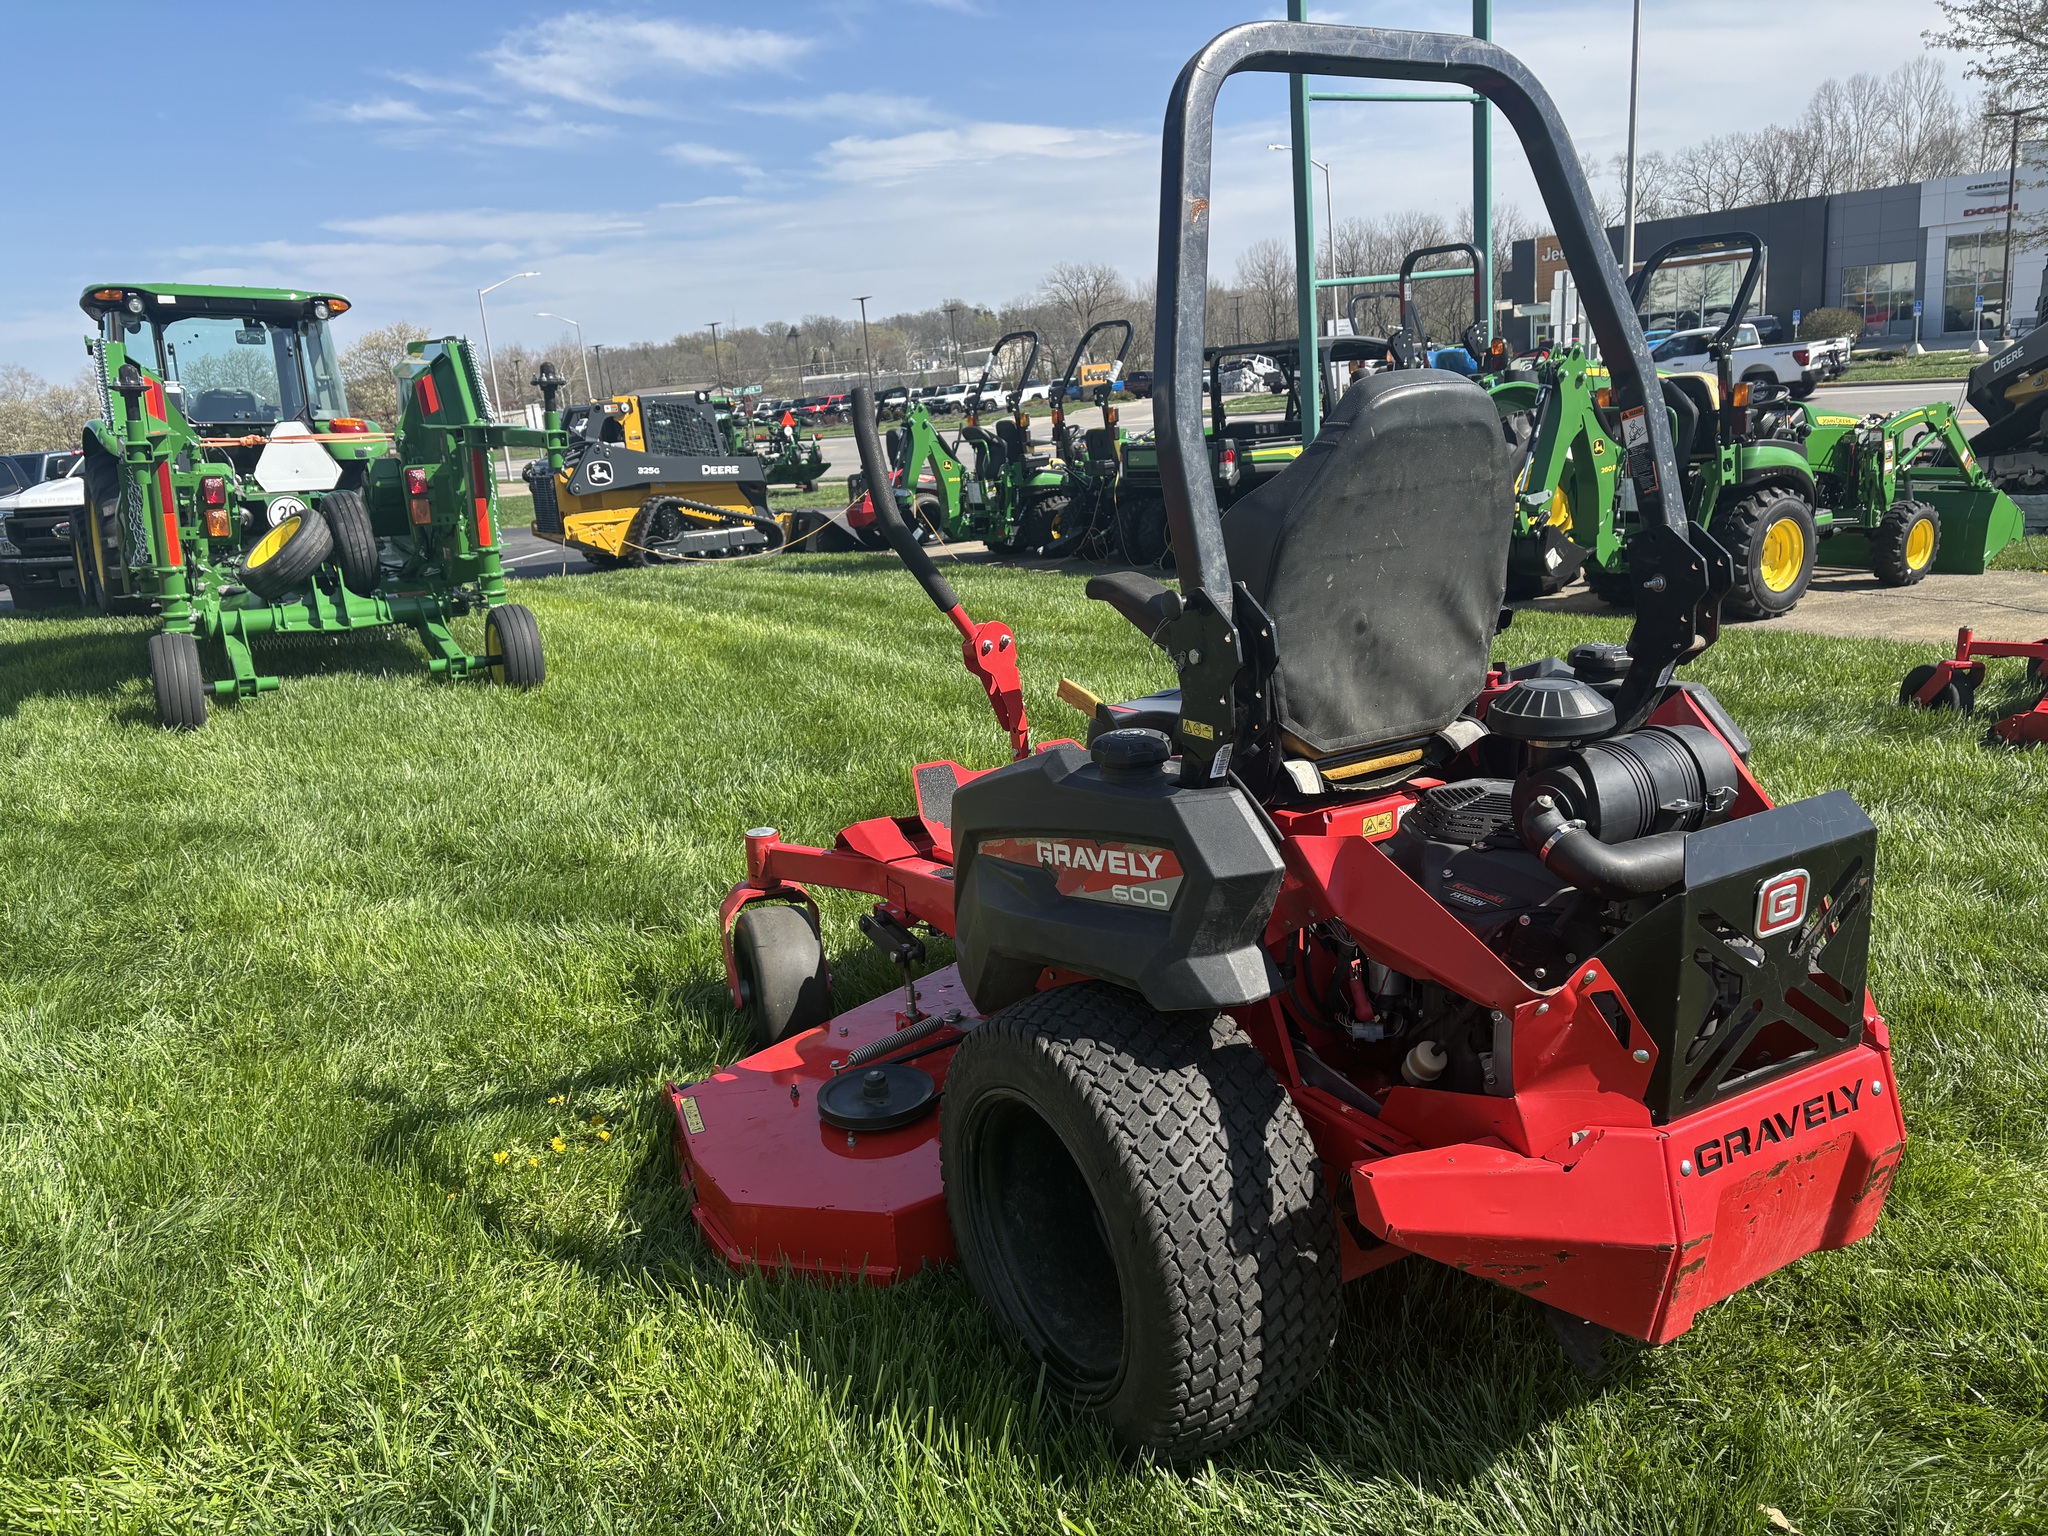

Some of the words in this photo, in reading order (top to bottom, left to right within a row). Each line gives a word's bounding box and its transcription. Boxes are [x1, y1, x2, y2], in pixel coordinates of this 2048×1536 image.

[1966, 181, 2010, 191] CHRYSL
[1541, 247, 1566, 262] Jee
[1993, 345, 2025, 374] DEERE
[637, 467, 660, 475] 325G
[702, 465, 740, 475] DEERE
[1036, 841, 1163, 879] GRAVELY
[1112, 884, 1168, 907] 600
[1449, 891, 1488, 906] FX1000V
[1452, 883, 1506, 904] Kawasaki
[1694, 1078, 1864, 1177] GRAVELY
